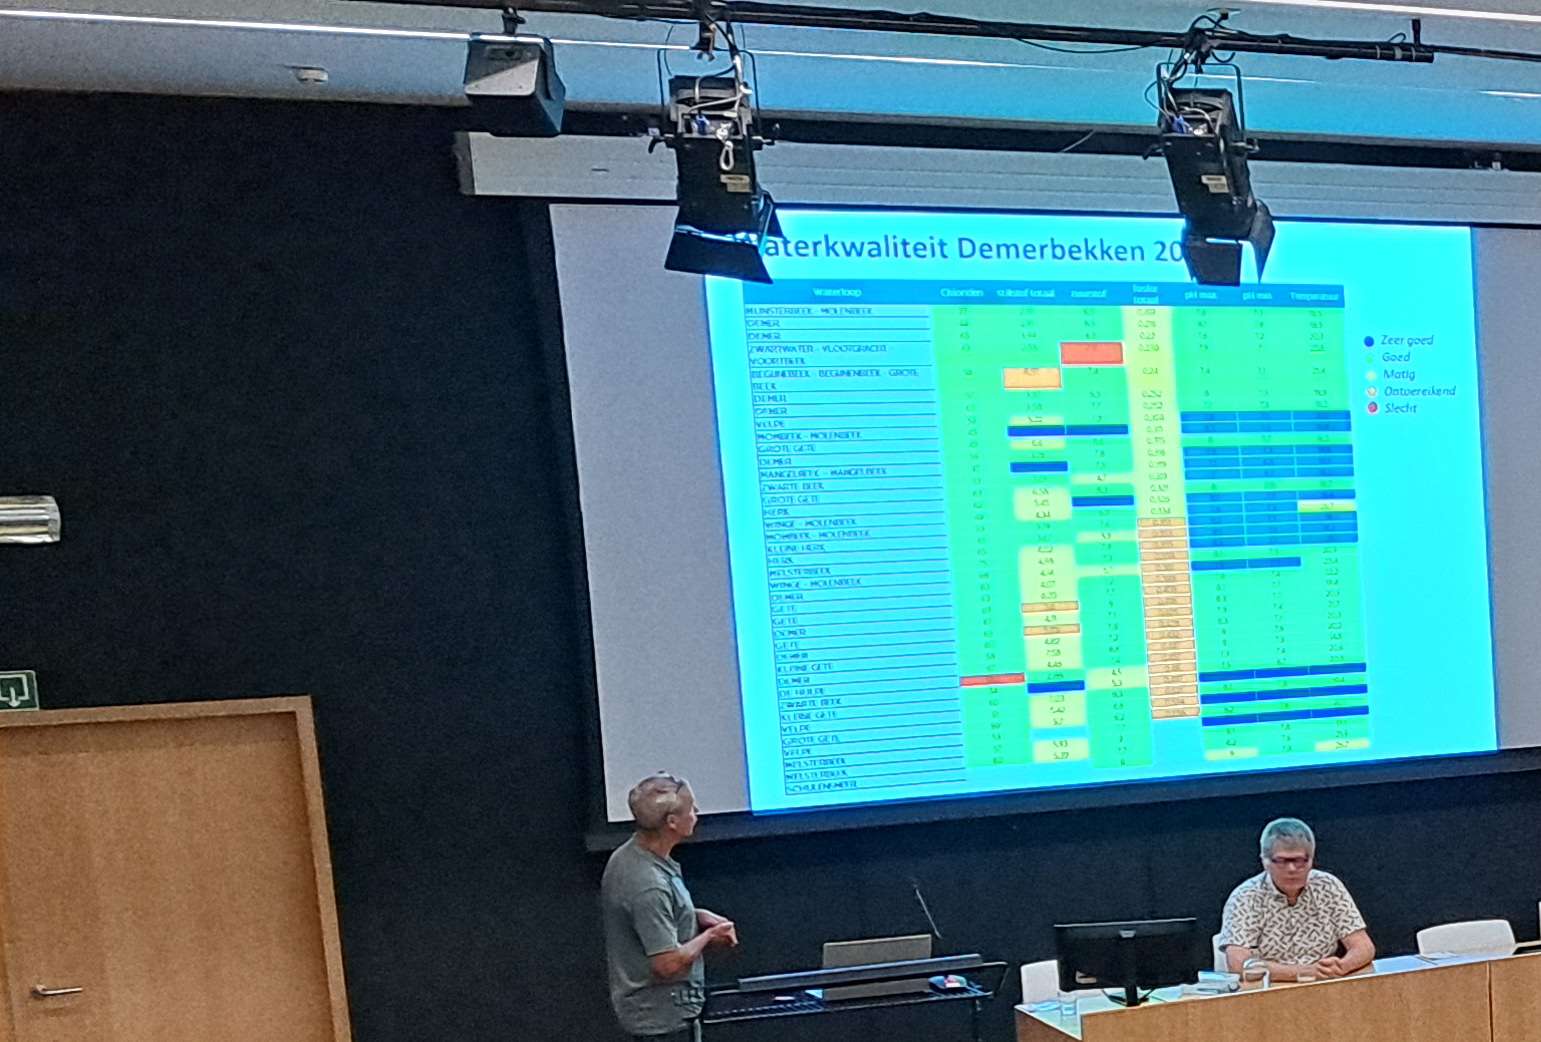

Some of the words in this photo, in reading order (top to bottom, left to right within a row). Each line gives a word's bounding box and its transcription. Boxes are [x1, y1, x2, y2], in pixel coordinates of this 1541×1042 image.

[764, 233, 949, 259] aterkwaliteit
[957, 237, 1145, 262] Demerbekken
[1154, 240, 1184, 263] 20
[812, 287, 862, 298] Waterloop
[1381, 335, 1405, 346] Zeer
[1407, 335, 1434, 347] goed
[1382, 352, 1410, 363] Goed
[1383, 369, 1416, 382] Matig
[1385, 402, 1417, 413] Slecht
